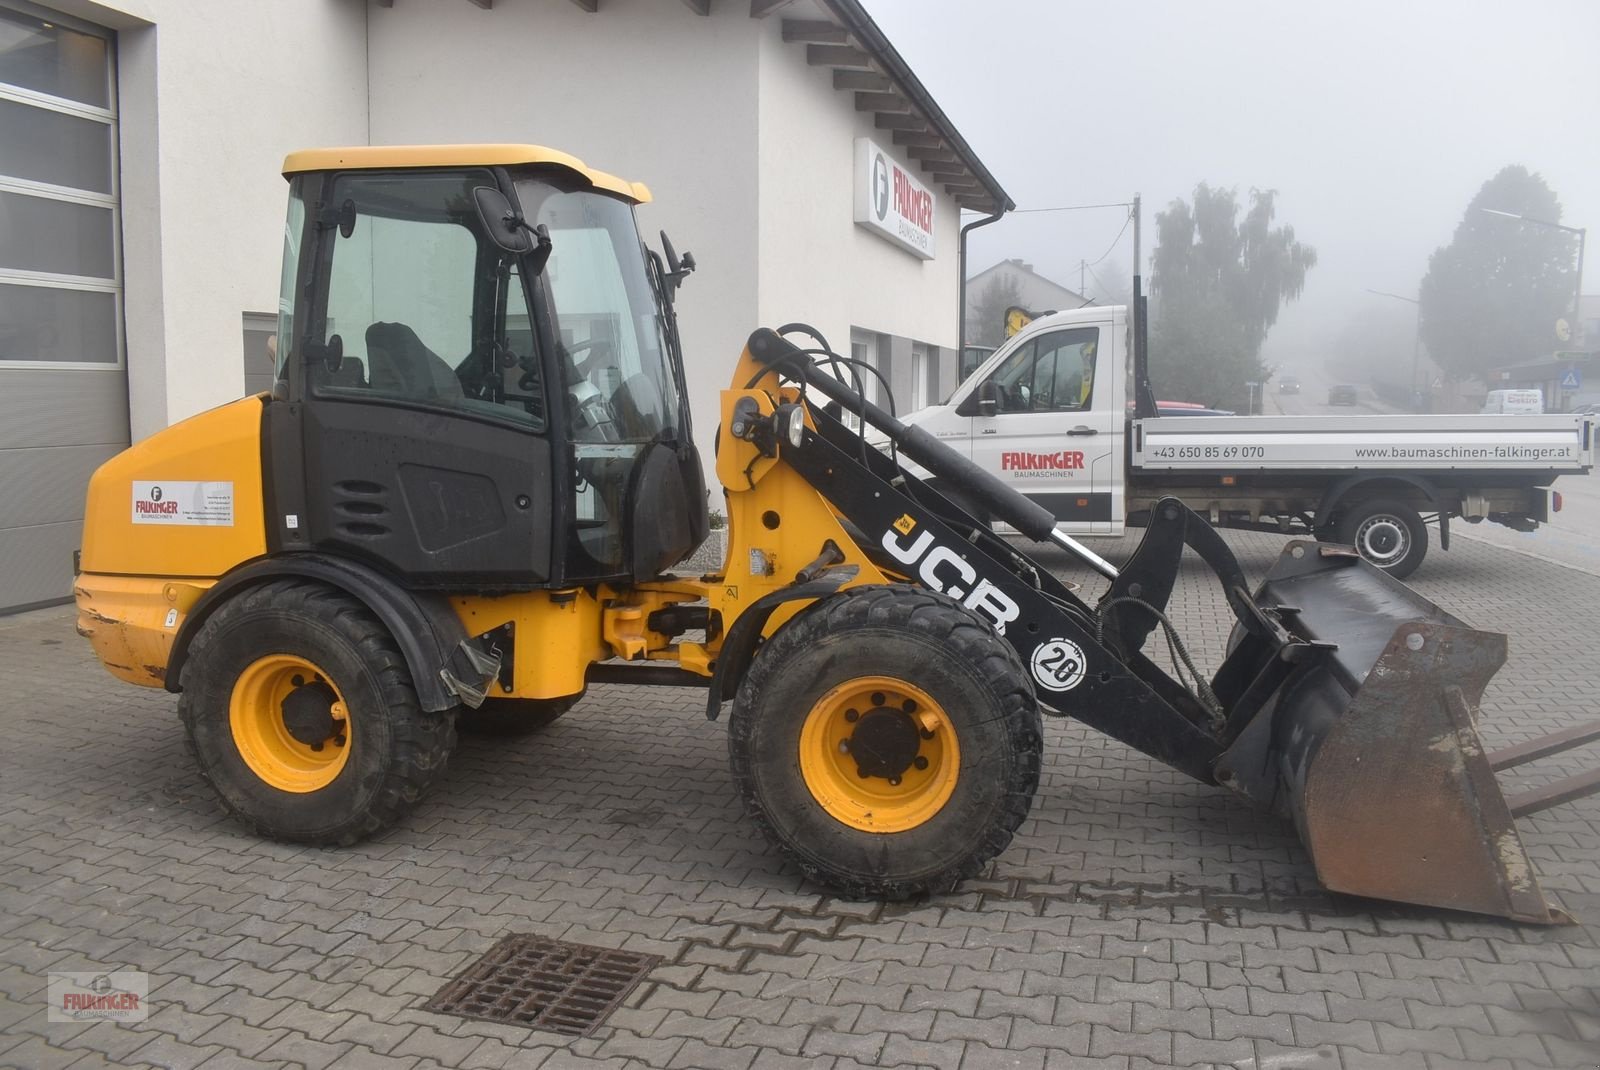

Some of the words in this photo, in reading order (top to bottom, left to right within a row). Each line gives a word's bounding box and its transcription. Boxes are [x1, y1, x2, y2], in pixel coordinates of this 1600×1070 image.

[893, 165, 932, 235] FALKINGER
[1002, 451, 1084, 470] FALKINGER
[1153, 447, 1175, 458] +43
[1179, 447, 1201, 458] 650
[1204, 447, 1219, 458] 85
[1223, 447, 1238, 458] 69
[1241, 447, 1265, 458] 070
[1355, 446, 1571, 460] www.baumaschinen-falkinger.at
[136, 501, 178, 514] FALKINGER
[881, 529, 1021, 637] JCB
